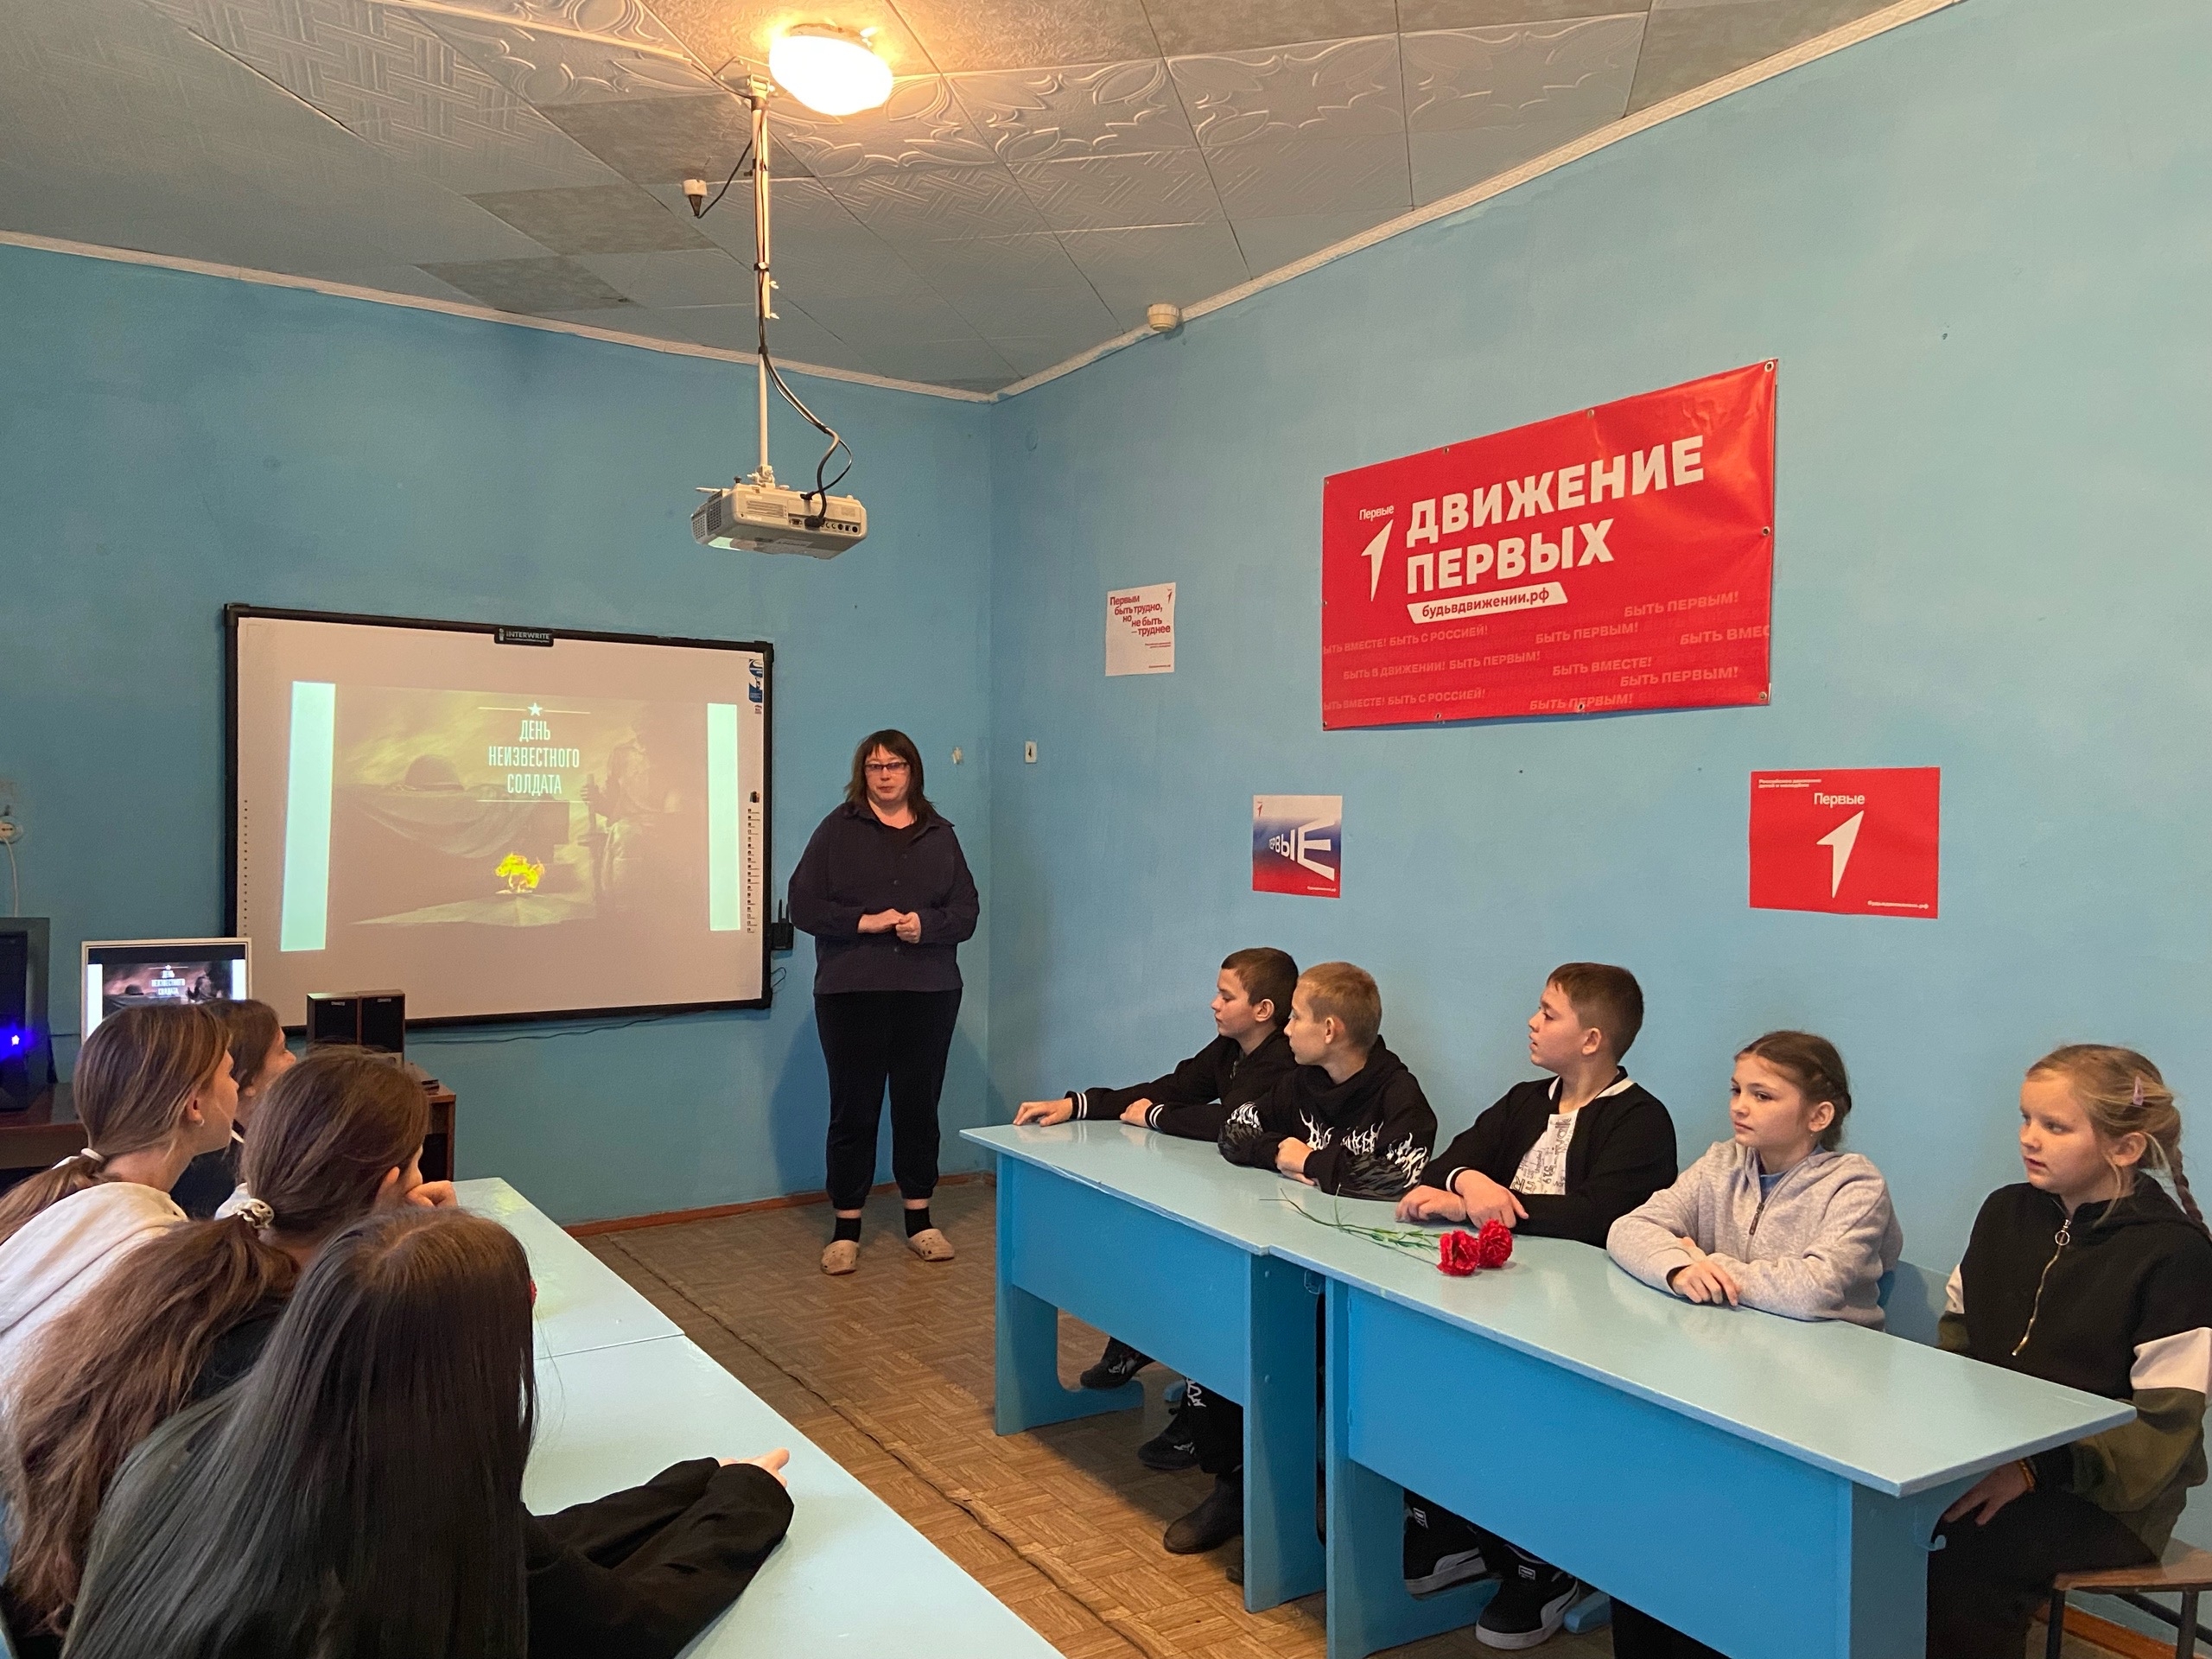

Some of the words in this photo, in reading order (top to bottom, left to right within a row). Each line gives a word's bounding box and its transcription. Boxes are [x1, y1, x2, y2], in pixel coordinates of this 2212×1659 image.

[1406, 435, 1704, 549] ДВИЖЕНИЕ
[1359, 504, 1395, 522] Первые
[1406, 518, 1615, 594] ПЕРВЫХ
[1110, 595, 1140, 606] Первым
[1115, 606, 1133, 615] быть
[1134, 603, 1163, 614] трудно,
[1421, 588, 1549, 618] будьвдвижении.рф
[1624, 603, 1664, 617] БЫТЬ
[1667, 591, 1738, 613] ПЕРВЫМ!
[1132, 619, 1141, 627] не
[1141, 616, 1162, 626] быть
[1138, 626, 1171, 637] труднее
[1344, 638, 1386, 652] ВМЕСТЕ!
[1389, 634, 1419, 646] БЫТЬ
[1421, 633, 1429, 642] С
[1430, 625, 1488, 641] РОССИЕЙ!
[1535, 632, 1570, 645] БЫТЬ
[1573, 622, 1638, 640] ПЕРВЫМ!
[1680, 631, 1723, 645] БЫТЬ
[1344, 669, 1370, 680] БЫТЬ
[1380, 661, 1446, 678] ДВИЖЕНИИ!
[1449, 658, 1481, 670] БЫТЬ
[1484, 651, 1541, 666] ПЕРВЫМ!
[1553, 664, 1588, 676] БЫТЬ
[1591, 657, 1652, 673] ВМЕСТЕ!
[1620, 673, 1659, 687] БЫТЬ
[1661, 667, 1738, 683] ПЕРВЫМ!
[1343, 697, 1385, 709] ВМЕСТЕ!
[1388, 694, 1417, 706] БЫТЬ
[1419, 694, 1426, 703] С
[1428, 689, 1485, 703] РОССИЕЙ!
[1529, 699, 1566, 711] БЫТЬ
[519, 720, 551, 742] ДЕНЬ
[488, 746, 580, 768] НЕИЗВЕСТНОГО
[507, 773, 562, 797] СОЛДАТА
[1814, 792, 1866, 808] Первые
